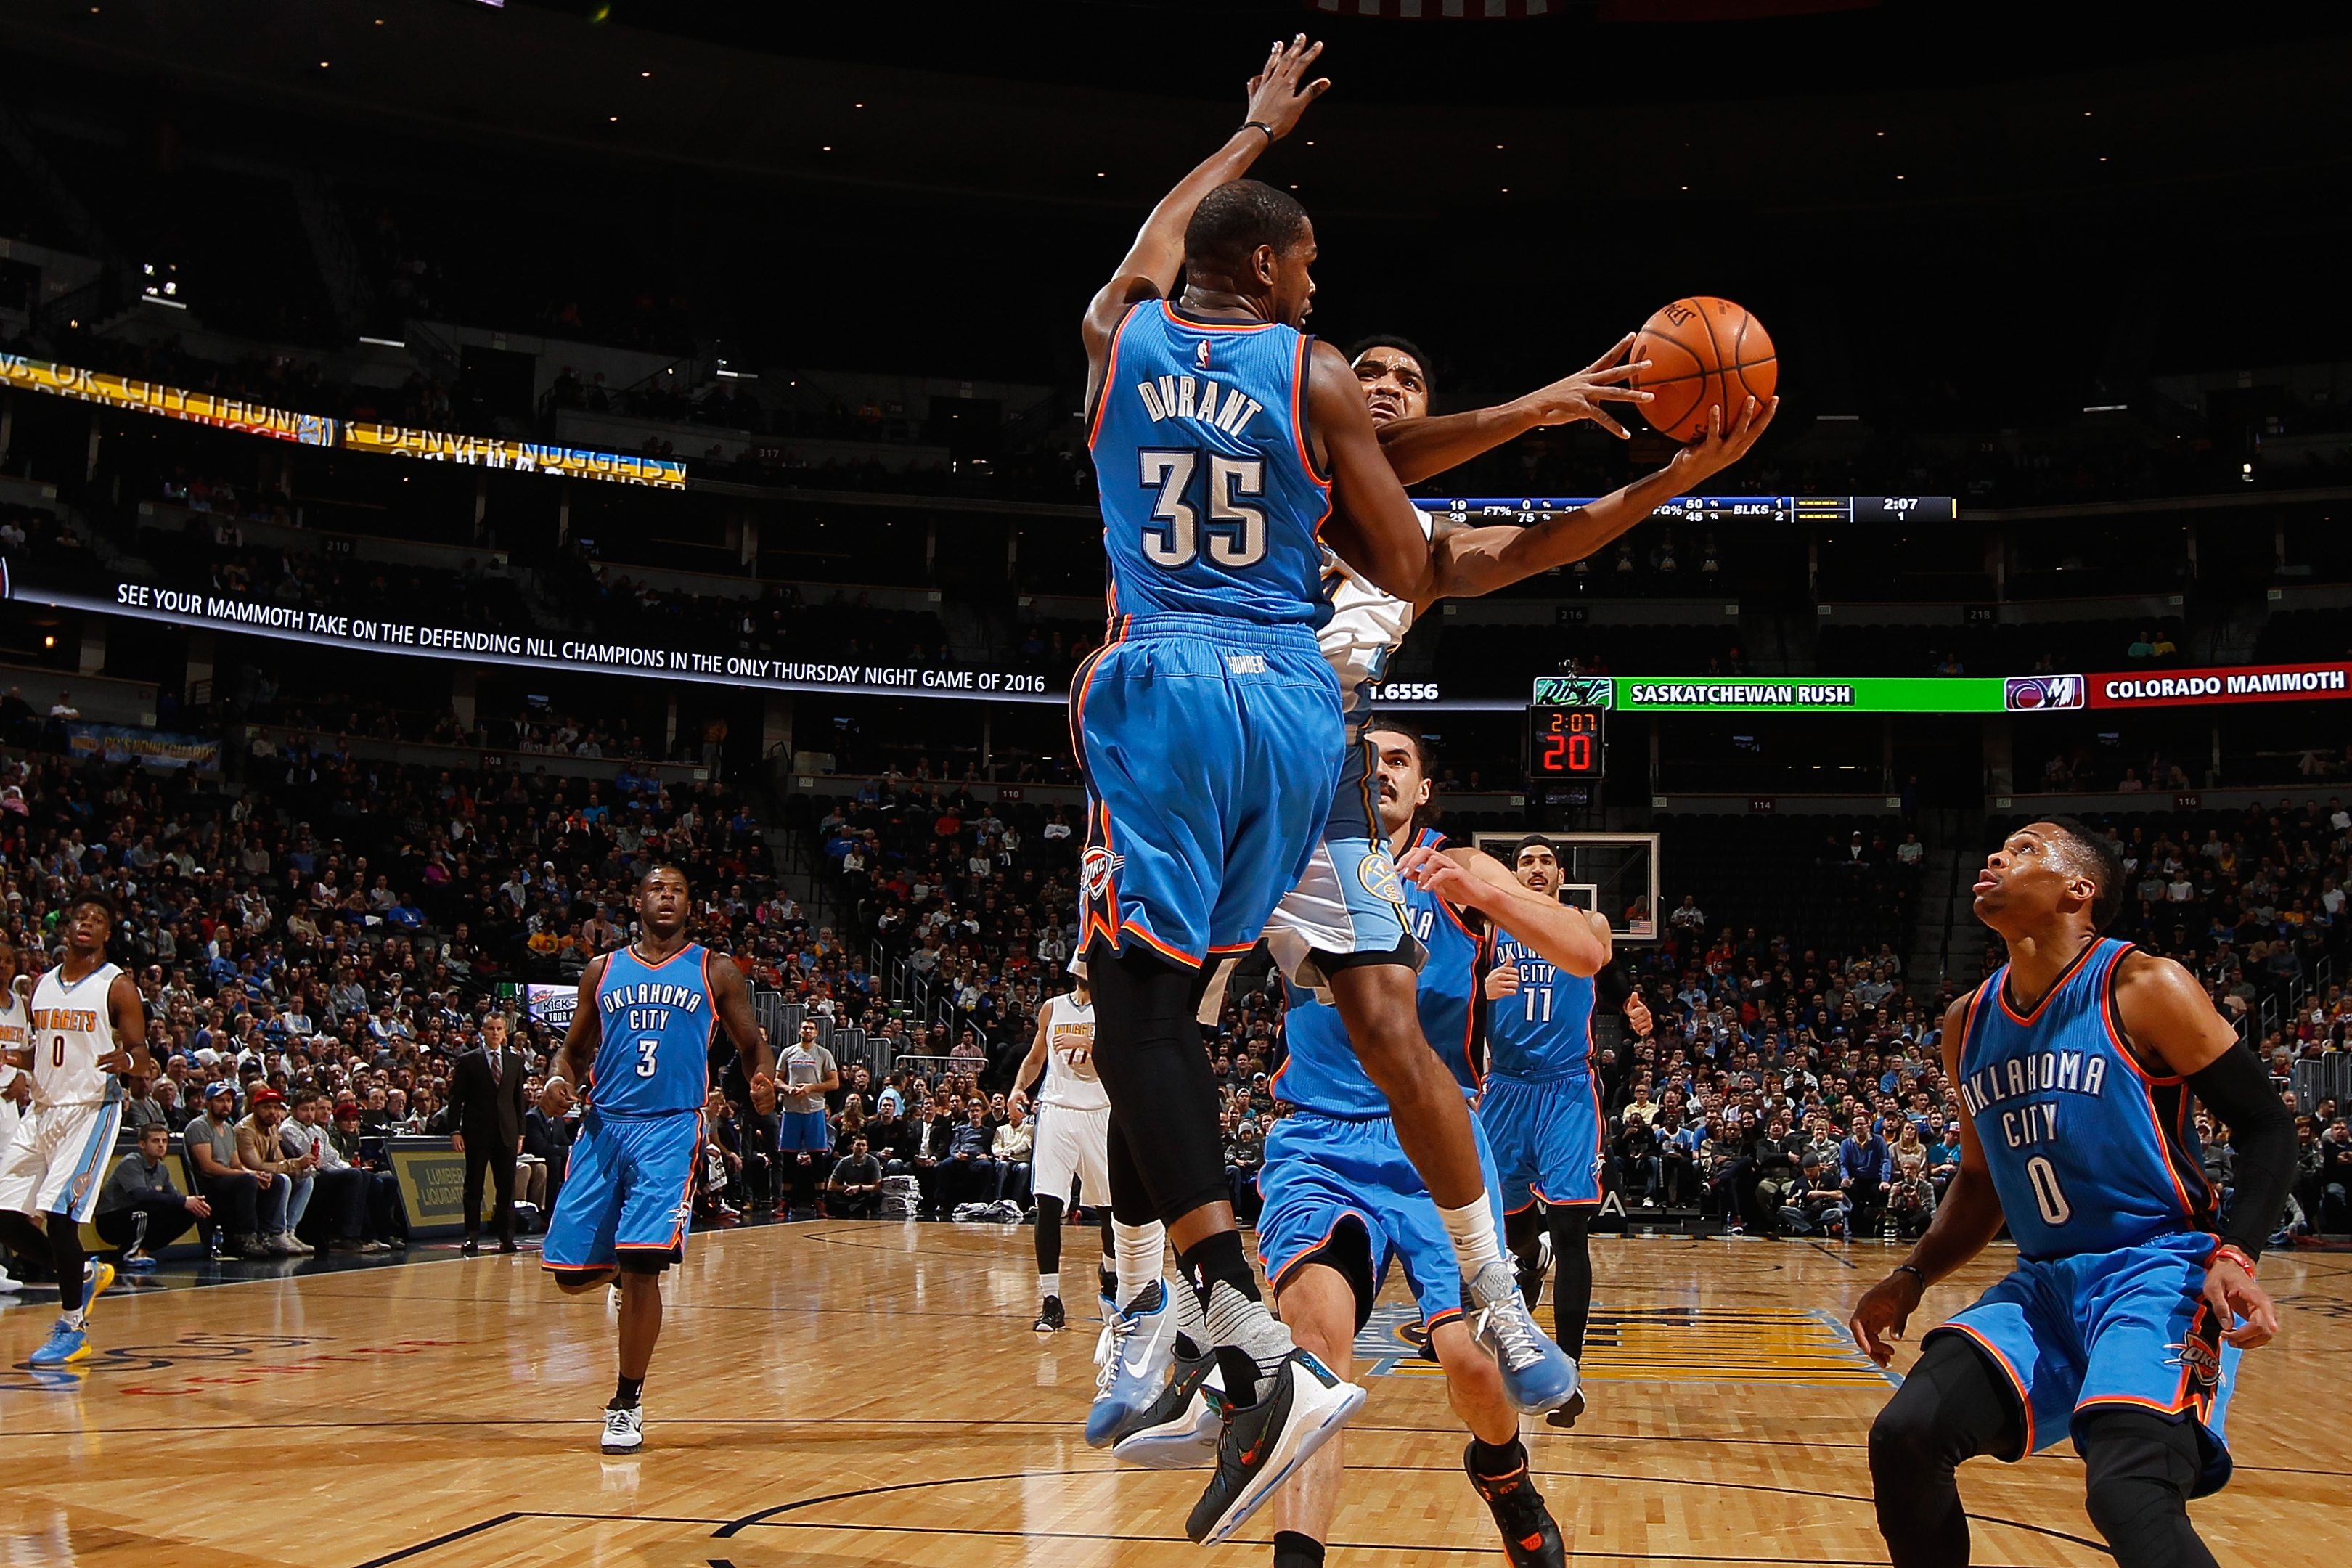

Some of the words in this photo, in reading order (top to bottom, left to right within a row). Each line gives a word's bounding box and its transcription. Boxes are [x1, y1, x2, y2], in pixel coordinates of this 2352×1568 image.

[1137, 375, 1262, 438] DURANT
[759, 448, 780, 458] 317
[1138, 446, 1270, 571] 35
[1450, 499, 1466, 510] 19
[1482, 506, 1512, 516] FT%
[1652, 505, 1683, 516] FG%
[1686, 499, 1703, 509] 50
[1733, 505, 1770, 515] BLKS
[1775, 499, 1783, 509] 1
[1883, 498, 1919, 510] 2:07
[1449, 513, 1466, 523] 29
[1517, 513, 1535, 523] 75
[1686, 512, 1703, 522] 45
[1774, 512, 1784, 522] 2
[1897, 512, 1905, 522] 1
[327, 540, 350, 552] 210
[1561, 610, 1583, 620] 216
[1970, 610, 1990, 620] 218
[117, 584, 149, 606] SEE
[153, 589, 202, 615] YOUR
[207, 597, 304, 629] MAMMOTH
[307, 612, 348, 636] TAKE
[352, 619, 377, 640] ON
[381, 623, 415, 644] THE
[419, 627, 521, 654] DEFENDING
[526, 637, 558, 658] NLL
[562, 642, 665, 668] CHAMPIONS
[670, 651, 687, 669] IN
[691, 653, 722, 673] THE
[727, 657, 769, 677] ONLY
[772, 661, 860, 683] THURSDAY
[865, 666, 918, 686] NIGHT
[922, 670, 973, 689] GAME
[978, 672, 1000, 690] OF
[1004, 674, 1045, 693] 2016
[1224, 655, 1266, 674] THUNDER
[1632, 685, 1792, 702] SASKATCHEWAN
[1798, 686, 1850, 702] RUSH
[2106, 677, 2221, 698] COLORADO
[2227, 671, 2345, 693] MAMMOTH
[1551, 714, 1596, 732] 2:07
[484, 756, 501, 764] 08
[1543, 735, 1591, 771] 20
[2178, 797, 2196, 806] 116
[1082, 857, 1106, 889] OKC
[1519, 964, 1556, 984] CITY
[601, 982, 702, 1020] OKLAHOMA
[1523, 987, 1552, 1022] 11
[34, 1008, 97, 1033] NUGGETS
[629, 1010, 670, 1032] CITY
[52, 1035, 65, 1068] 0
[635, 1038, 659, 1078] 3
[1962, 1050, 2106, 1119] OKLAHOMA
[2000, 1101, 2059, 1149] CITY
[425, 1167, 465, 1185] LUMBER
[2024, 1154, 2073, 1228] 0
[2182, 1346, 2217, 1368] OKC
[119, 1339, 469, 1395] CENTER
